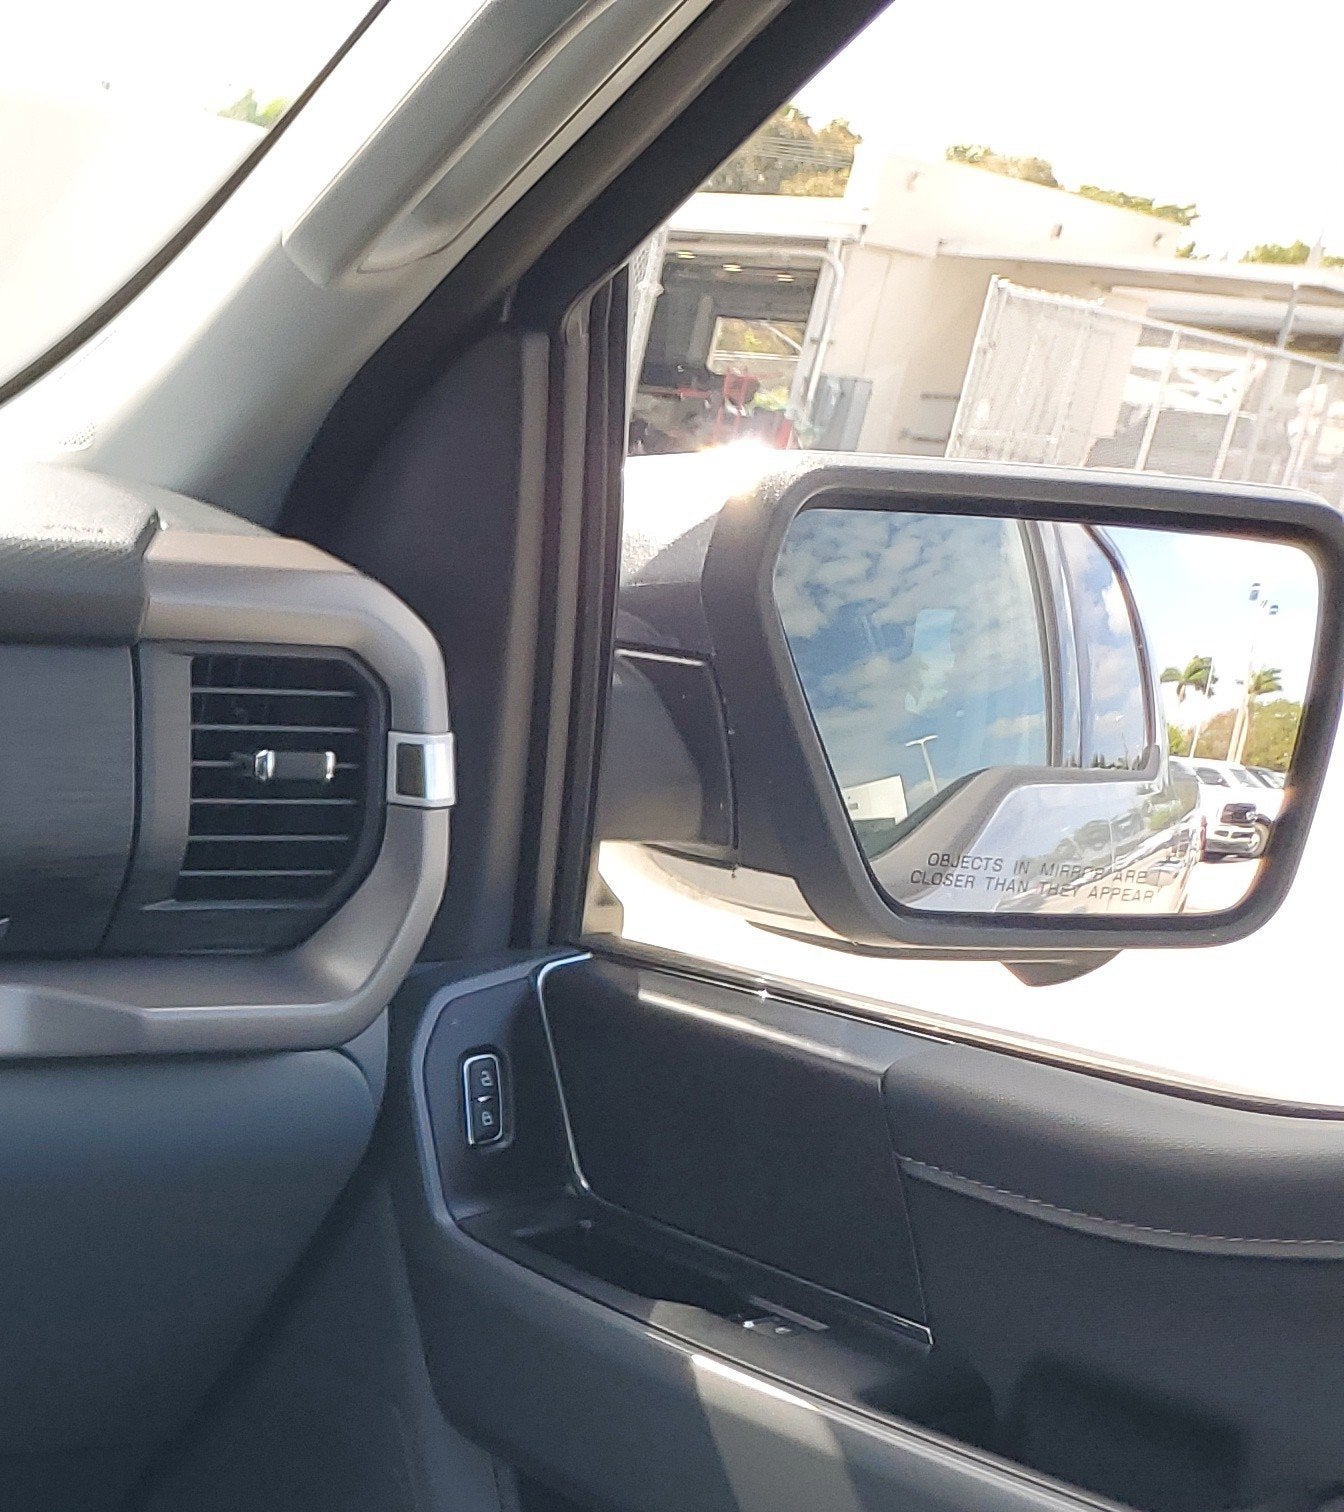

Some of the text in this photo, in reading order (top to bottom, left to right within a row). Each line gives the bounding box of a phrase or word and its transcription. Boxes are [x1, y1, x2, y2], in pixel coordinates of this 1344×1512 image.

[927, 852, 1149, 884] OBJECTS IN MIRROR ARE
[909, 869, 1155, 903] CLOSER THAN THEY APPEAR
